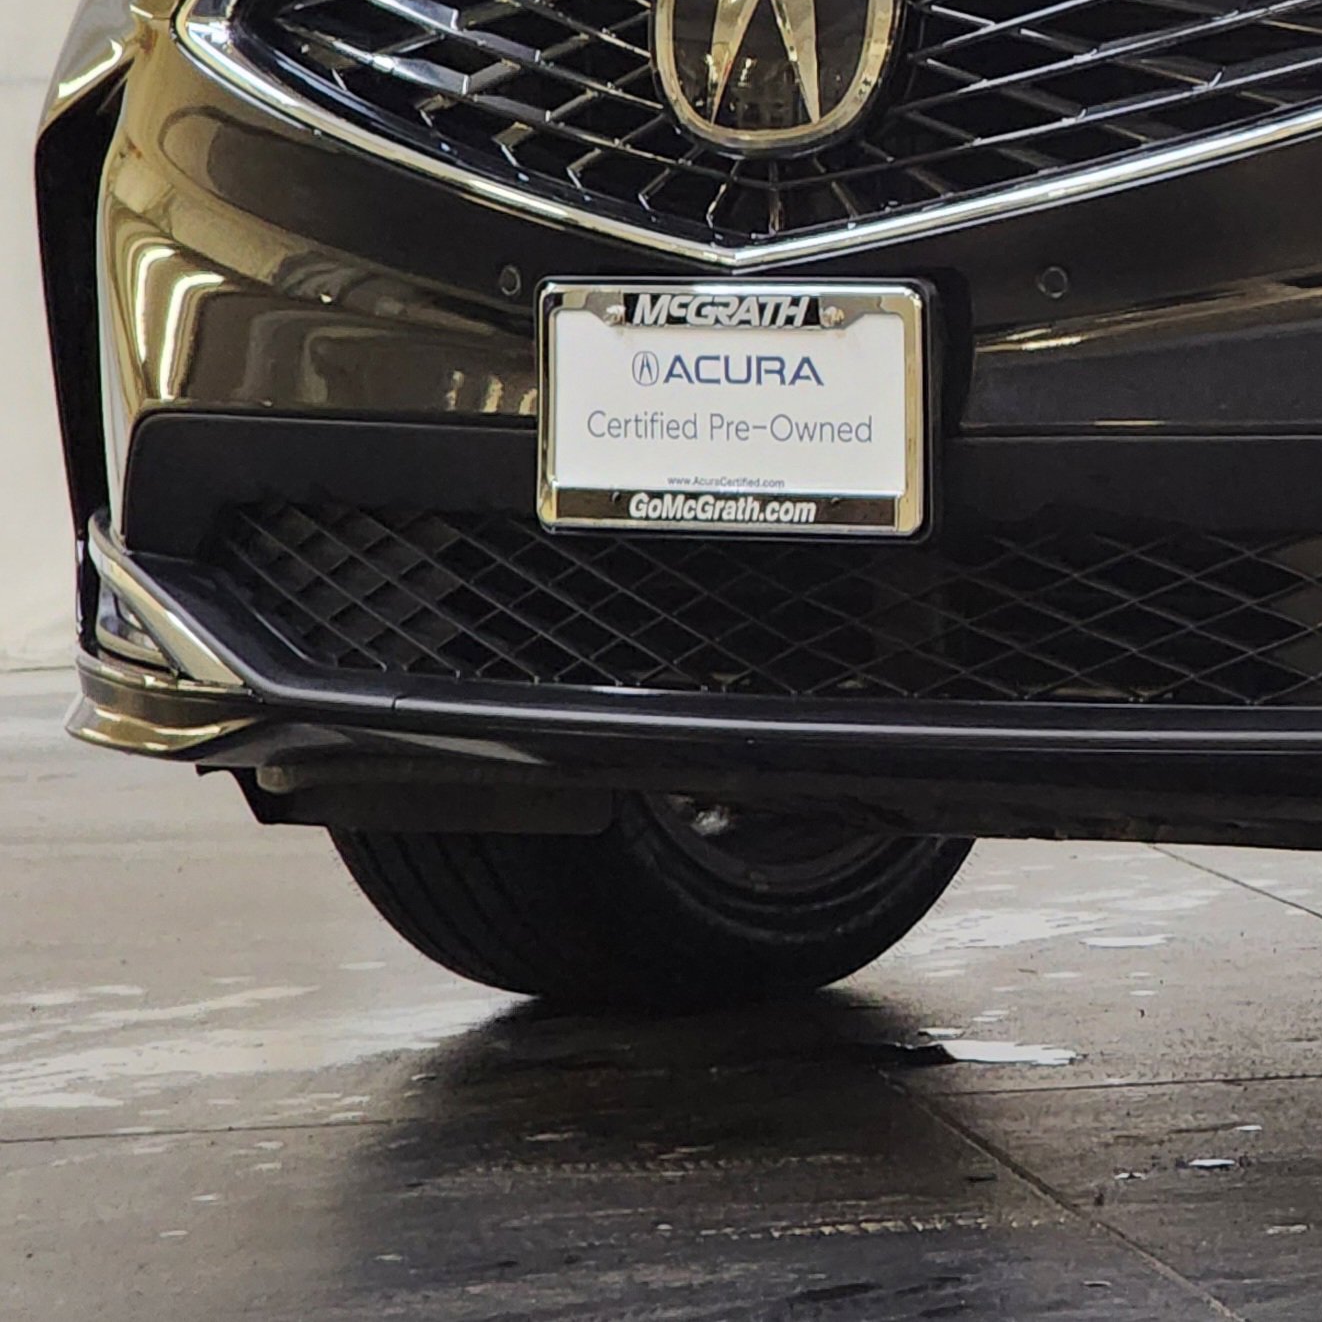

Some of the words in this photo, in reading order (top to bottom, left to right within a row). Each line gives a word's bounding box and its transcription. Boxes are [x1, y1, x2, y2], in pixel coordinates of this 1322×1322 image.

[663, 354, 824, 386] ACURA
[587, 410, 698, 440] Certified
[709, 413, 873, 443] Pre-Owned
[667, 476, 785, 489] www.AcuraCertified.com
[629, 492, 817, 523] GoMcGrath.com
